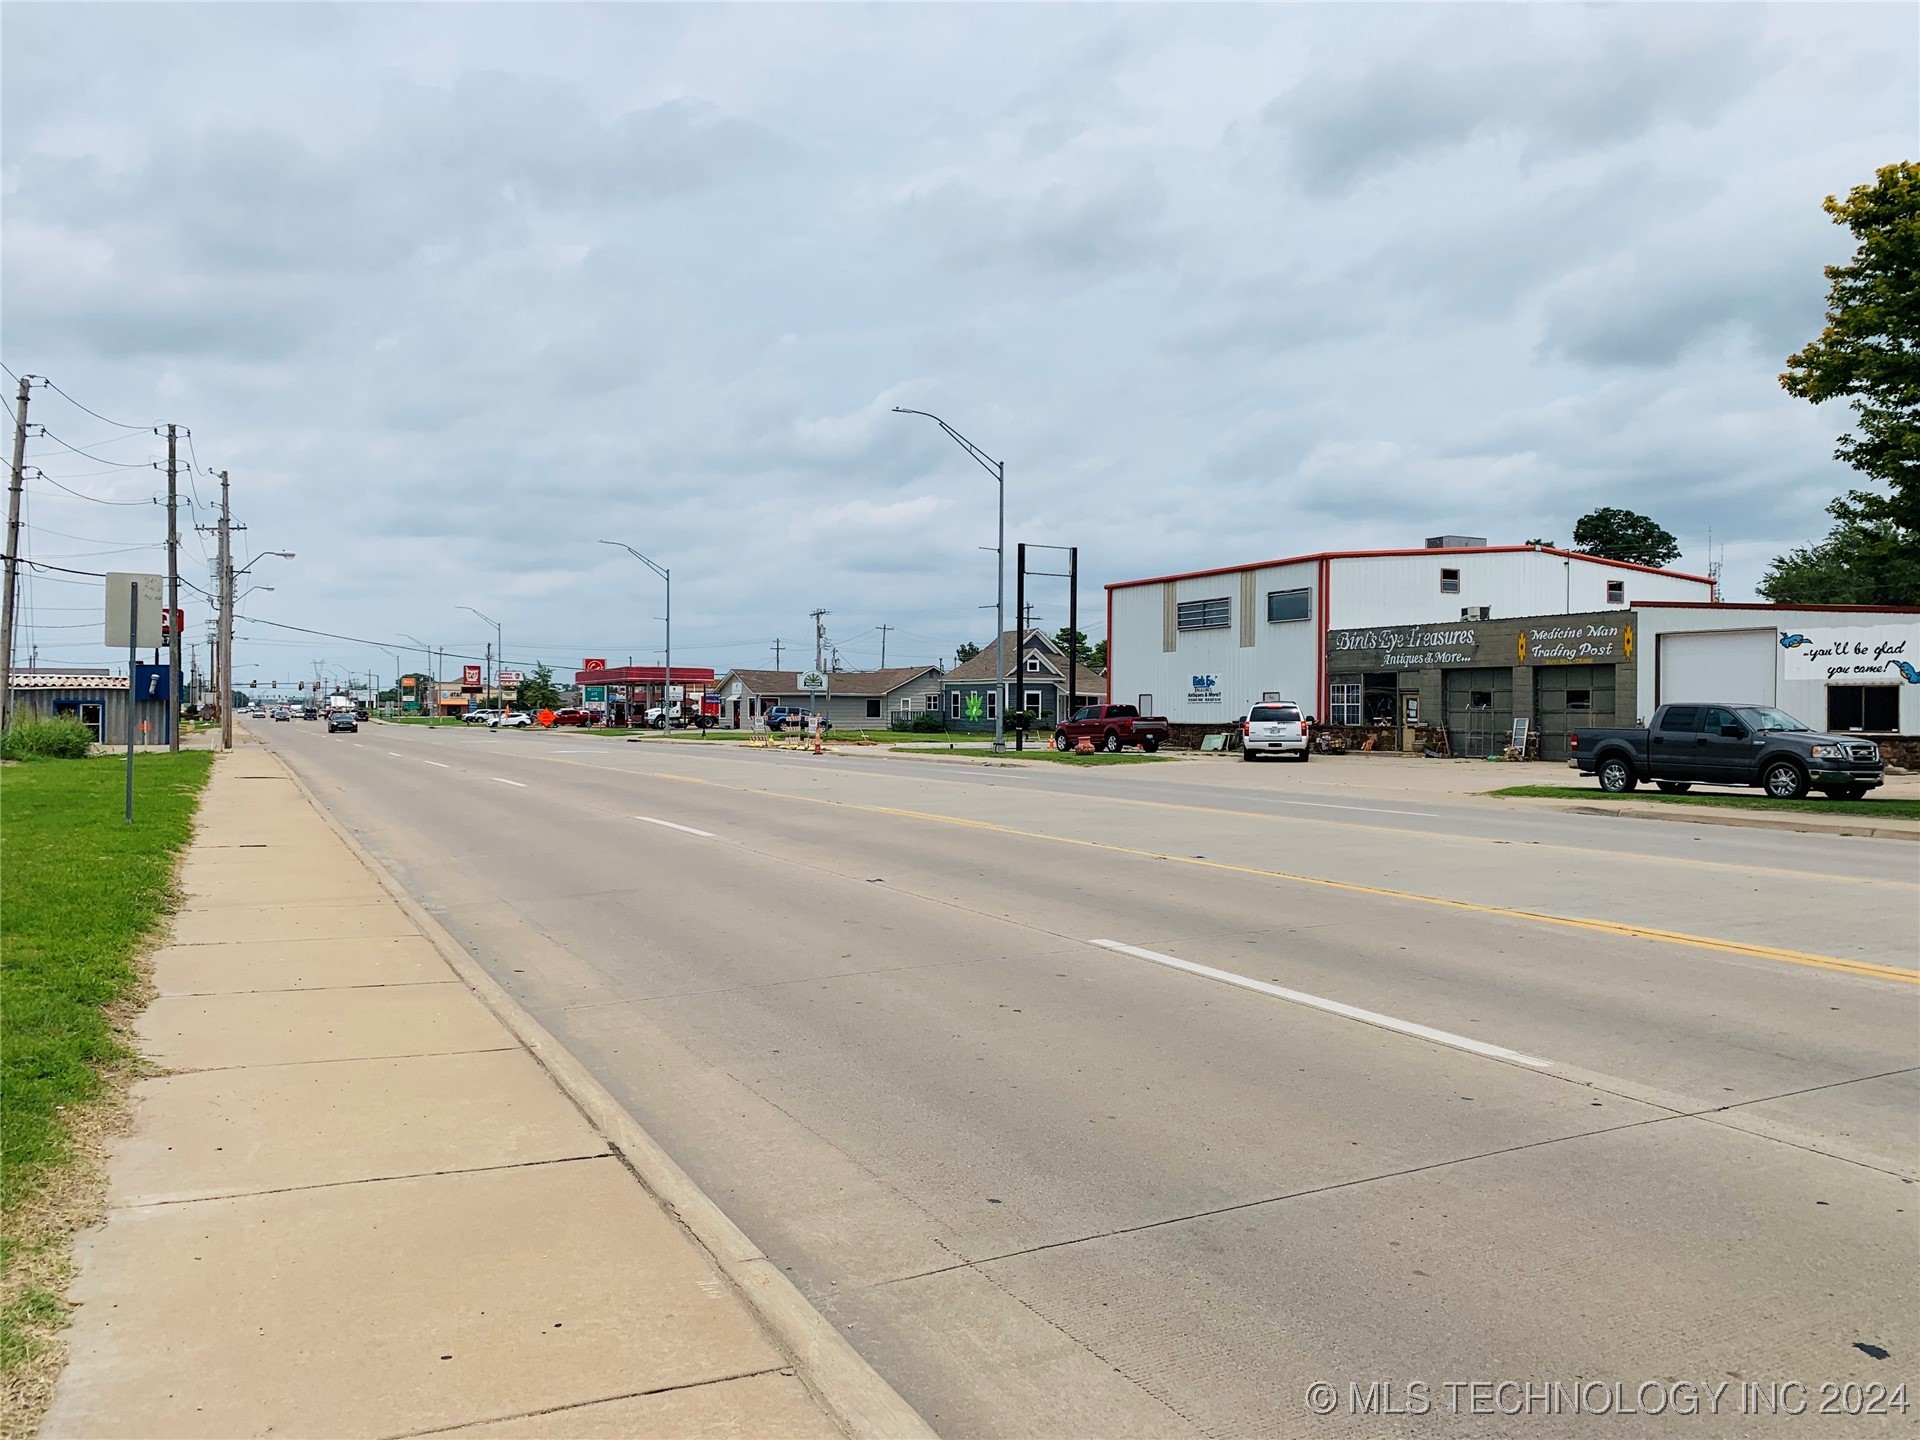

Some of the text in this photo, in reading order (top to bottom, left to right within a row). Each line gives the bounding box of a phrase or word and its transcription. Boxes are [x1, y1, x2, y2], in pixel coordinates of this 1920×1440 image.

[1336, 626, 1475, 653] Bird's Eye Treasures
[1529, 624, 1618, 640] Medicine Man
[1381, 653, 1424, 668] Antiques
[1424, 652, 1434, 664] &
[1531, 642, 1613, 660] Trading Post
[1854, 641, 1869, 655] be
[1874, 640, 1907, 661] glad
[1827, 660, 1892, 680] you came!
